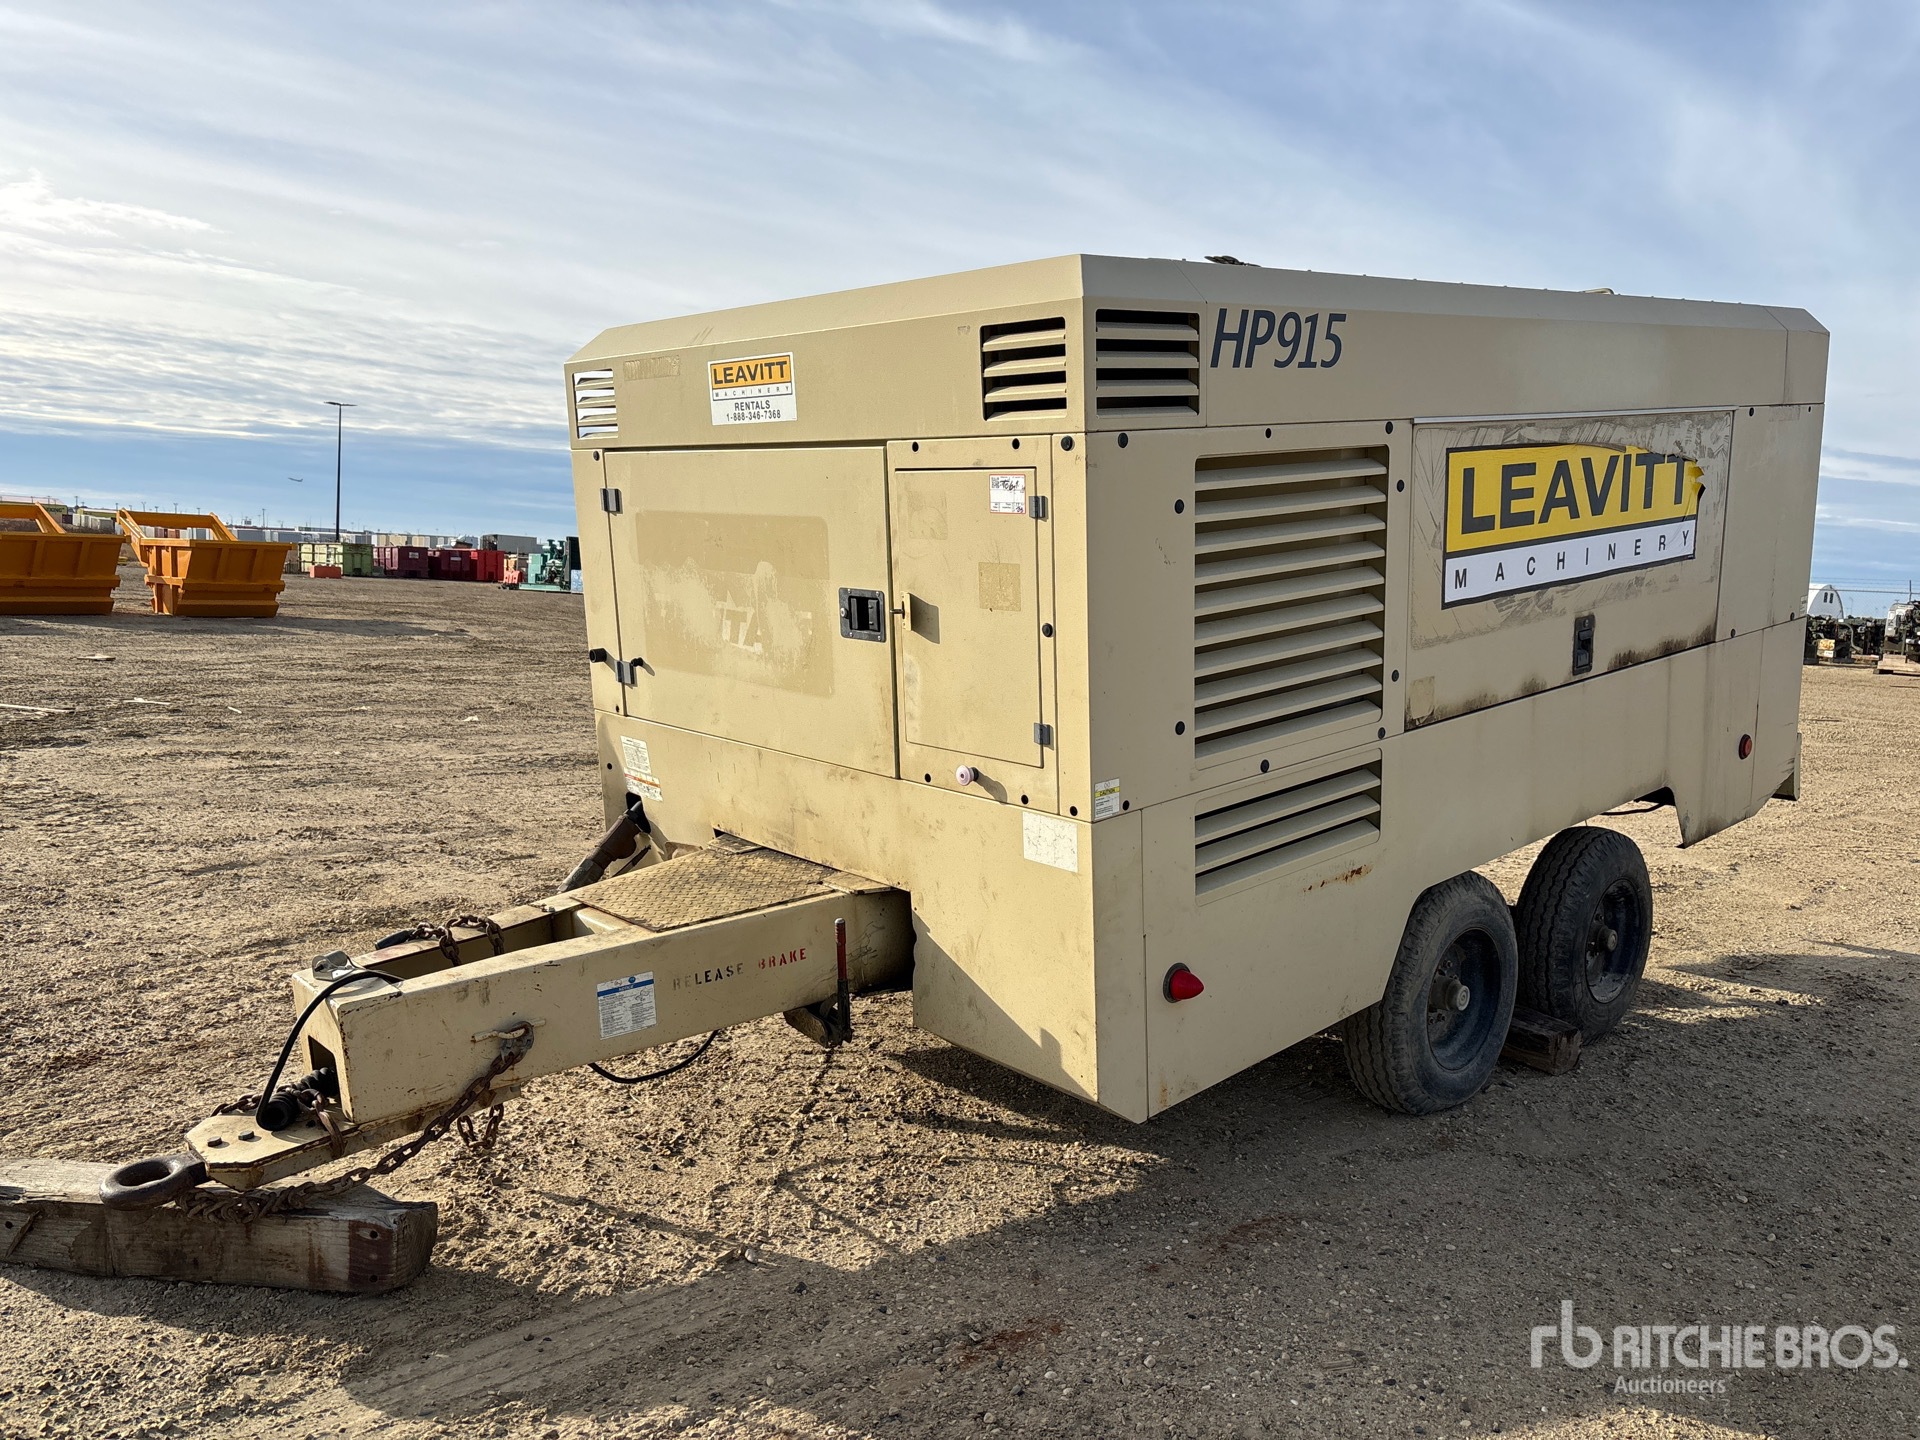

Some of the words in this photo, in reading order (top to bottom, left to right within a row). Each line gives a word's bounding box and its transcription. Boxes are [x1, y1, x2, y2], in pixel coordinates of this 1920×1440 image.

[1209, 307, 1347, 369] HP915
[713, 360, 788, 385] LEAVITT
[714, 385, 790, 398] MACHINERY
[734, 400, 771, 412] RENTALS
[726, 409, 782, 422] 1-888-346-7368
[1461, 452, 1685, 536] LEAVITT
[1453, 529, 1690, 590] MACHINERY
[673, 962, 744, 991] RELEASE
[758, 947, 807, 970] BRAKE
